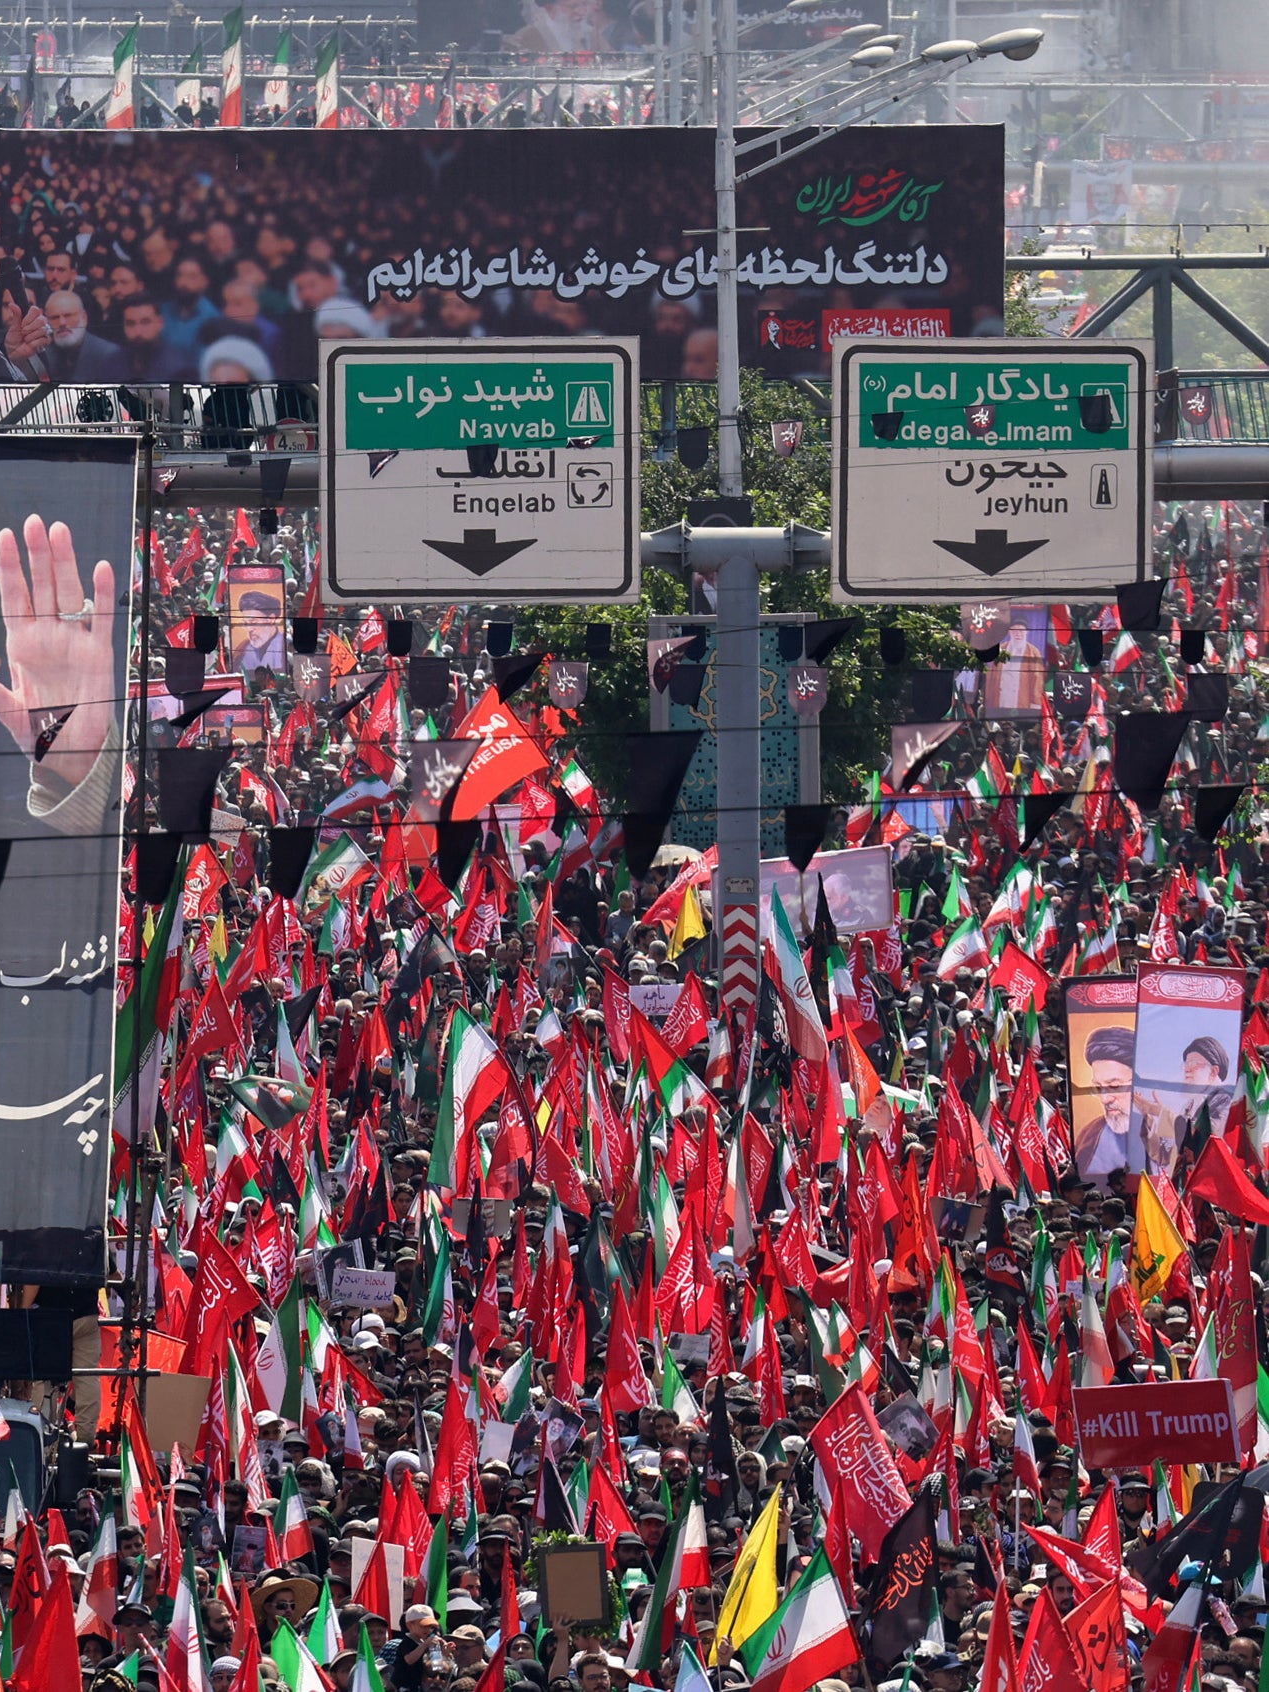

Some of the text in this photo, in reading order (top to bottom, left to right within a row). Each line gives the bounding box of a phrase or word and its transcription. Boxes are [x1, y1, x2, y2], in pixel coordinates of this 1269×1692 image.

[797, 176, 850, 225] ایران
[555, 247, 658, 299] خوش
[832, 240, 948, 287] دلتنگ
[357, 368, 555, 419] شهید نواب
[887, 371, 958, 413] امام
[969, 368, 1069, 412] یادگار
[459, 418, 556, 439] Navvab
[945, 460, 1068, 494] جیحون
[453, 493, 556, 516] Enqelab
[467, 733, 523, 775] THE USA
[0, 940, 67, 1006] لب
[64, 934, 109, 985] تشنه
[63, 1095, 105, 1156] چه
[335, 1273, 387, 1287] your blood
[1082, 1410, 1230, 1438] #Kill Trump
